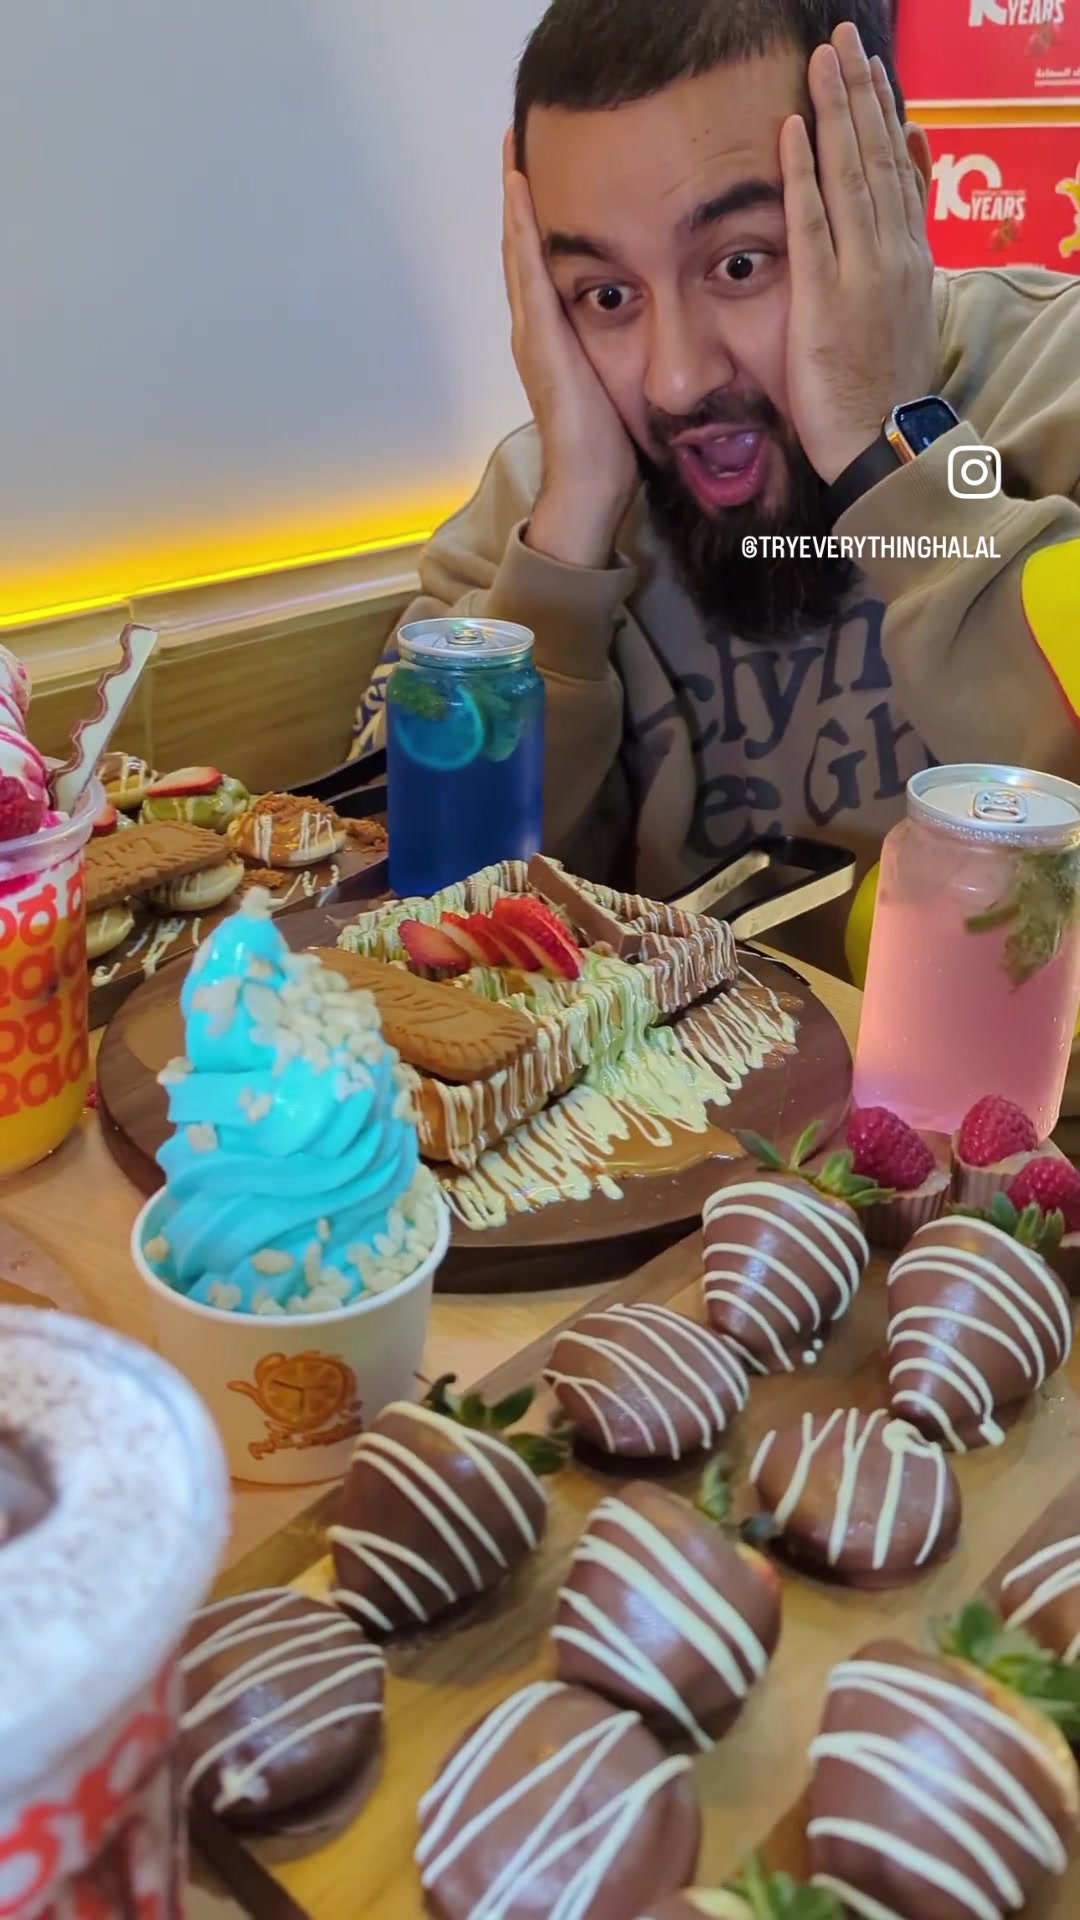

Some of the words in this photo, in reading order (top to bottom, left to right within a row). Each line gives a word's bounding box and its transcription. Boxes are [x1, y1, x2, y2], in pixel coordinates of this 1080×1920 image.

[1008, 0, 1066, 25] YEARS
[931, 153, 1003, 221] 10
[971, 195, 1026, 221] YEARS
